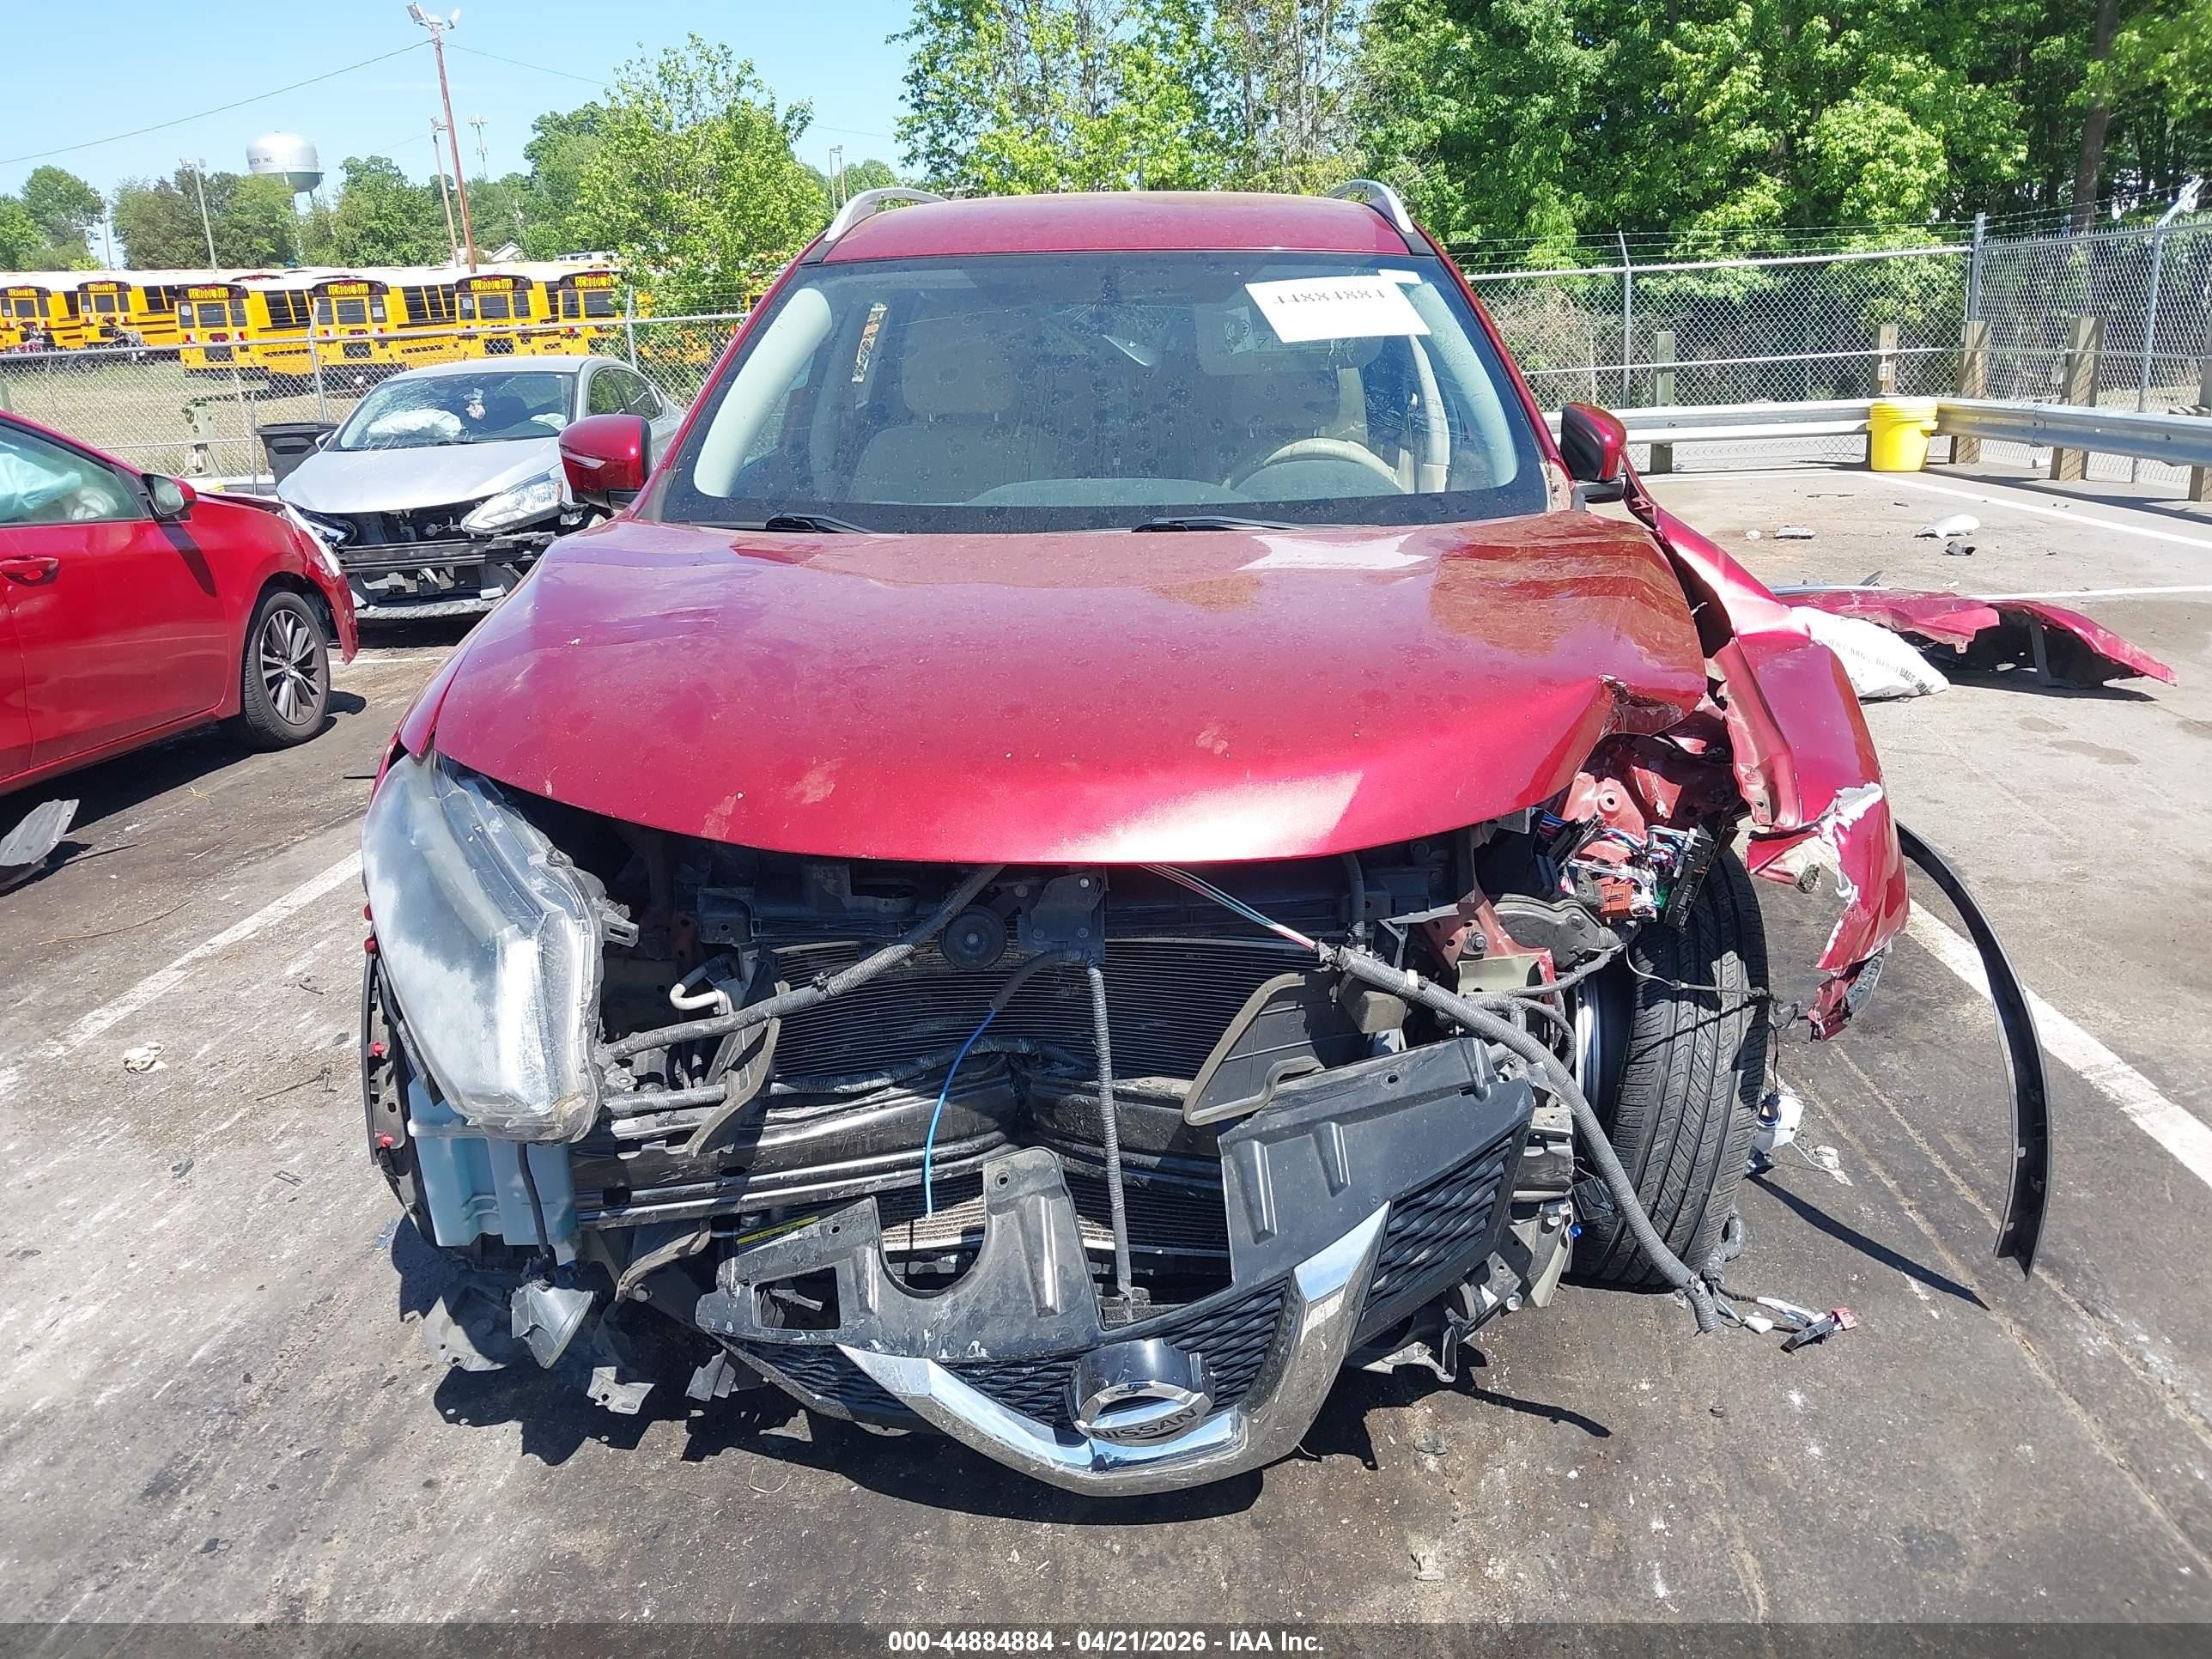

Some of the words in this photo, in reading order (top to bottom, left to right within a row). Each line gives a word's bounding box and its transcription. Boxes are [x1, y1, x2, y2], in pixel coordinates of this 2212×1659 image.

[471, 281, 497, 290] SCHOOL
[499, 280, 513, 289] BUS
[576, 277, 604, 288] SCHOOL
[189, 289, 215, 299] SCHOOL
[216, 289, 228, 298] BUS
[329, 286, 355, 295] SCHOOL
[356, 285, 368, 294] BUS
[1091, 1407, 1198, 1440] NISSAN
